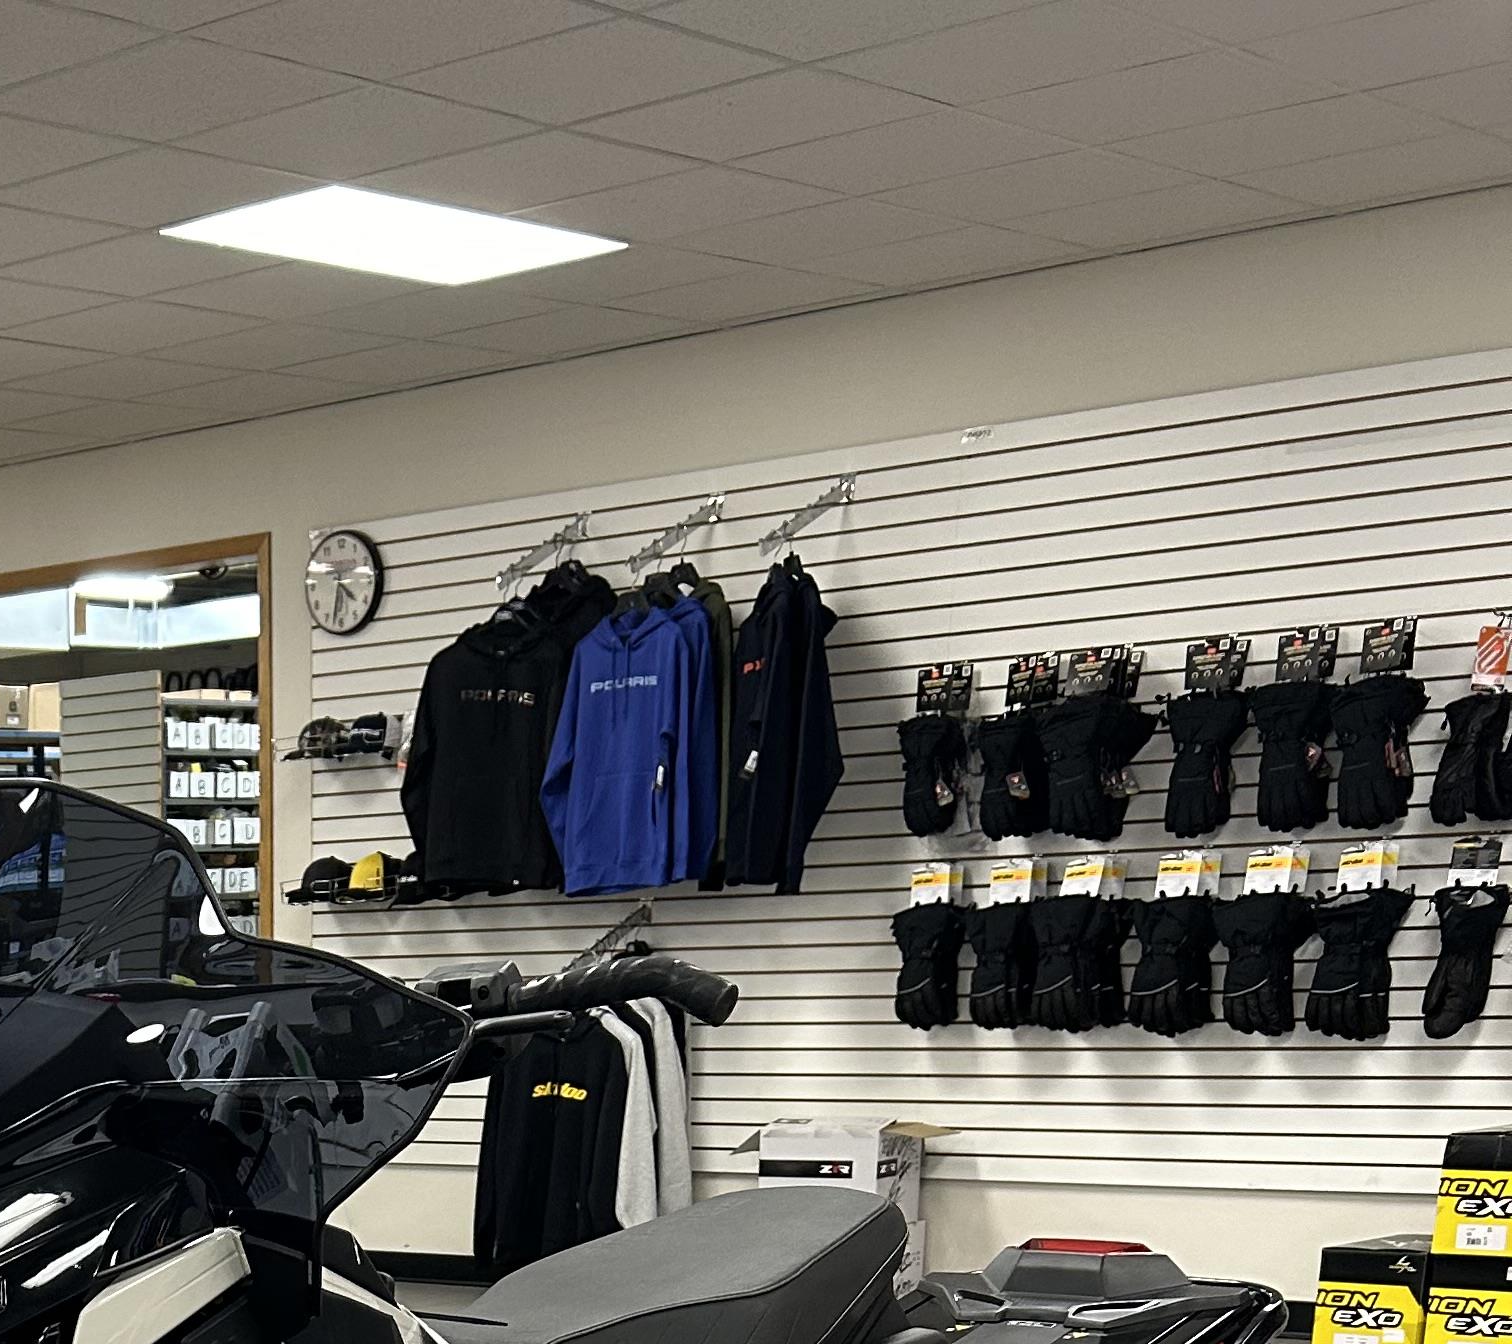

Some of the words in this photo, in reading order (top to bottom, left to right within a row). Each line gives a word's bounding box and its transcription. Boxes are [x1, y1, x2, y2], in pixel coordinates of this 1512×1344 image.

[221, 777, 231, 794] C
[243, 777, 252, 793] D
[218, 823, 227, 839] C
[245, 824, 255, 840] D
[1456, 1197, 1512, 1217] EX
[1332, 1308, 1403, 1328] EXO
